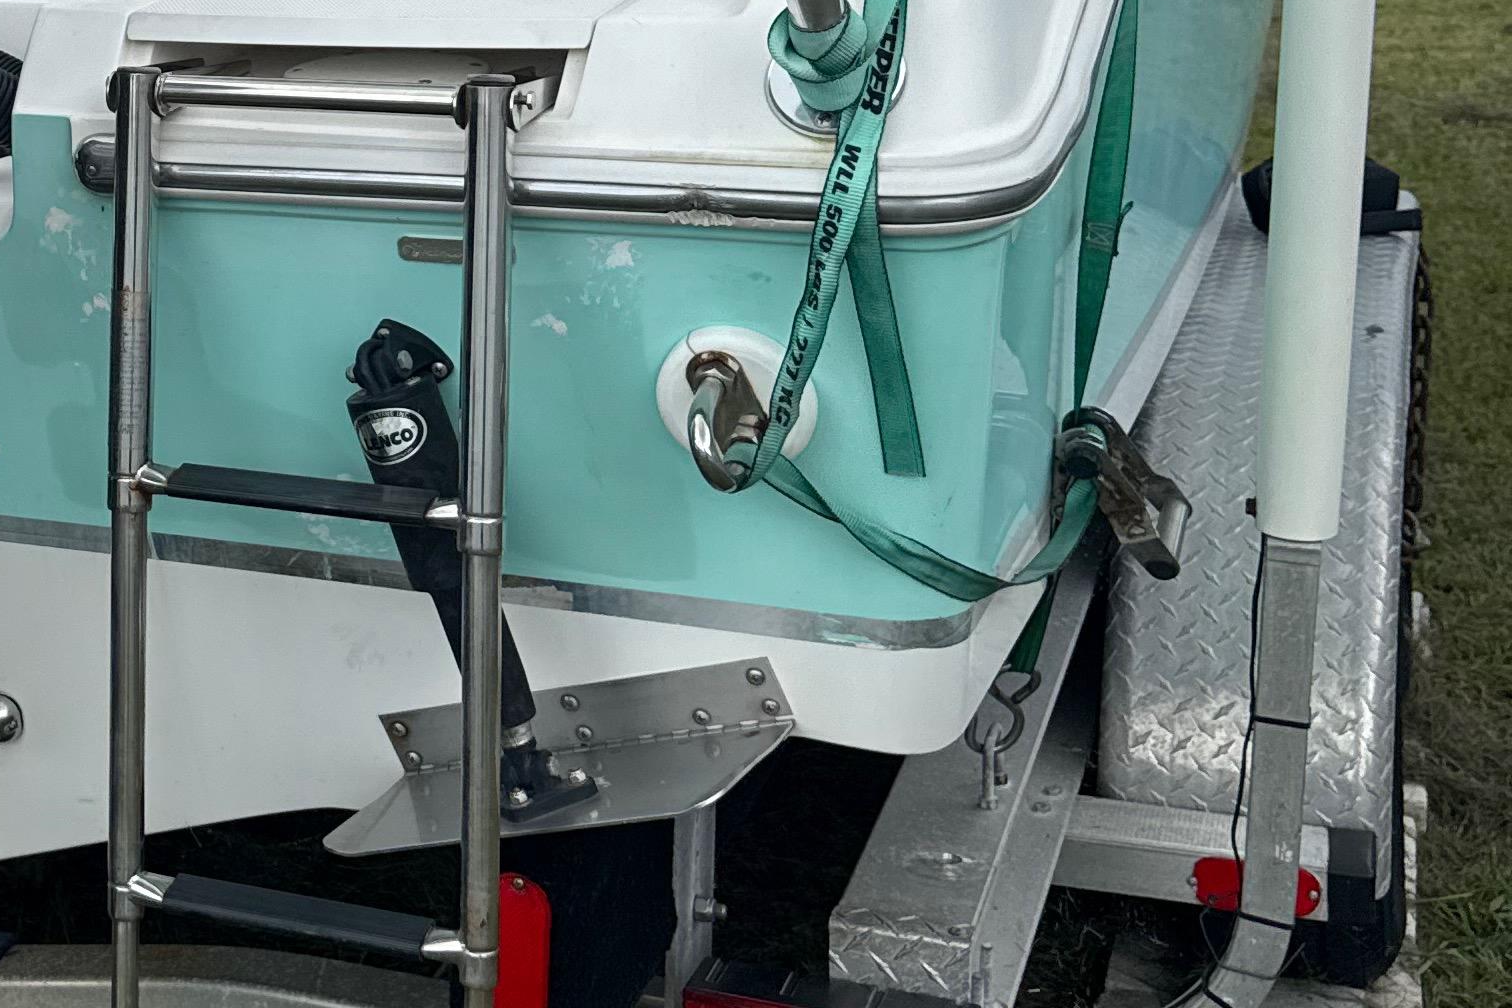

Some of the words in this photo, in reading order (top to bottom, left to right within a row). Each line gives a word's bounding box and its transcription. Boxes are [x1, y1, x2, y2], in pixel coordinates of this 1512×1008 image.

[831, 143, 862, 195] WLL
[819, 203, 843, 253] 500
[785, 335, 809, 381] 227
[774, 386, 794, 427] KG
